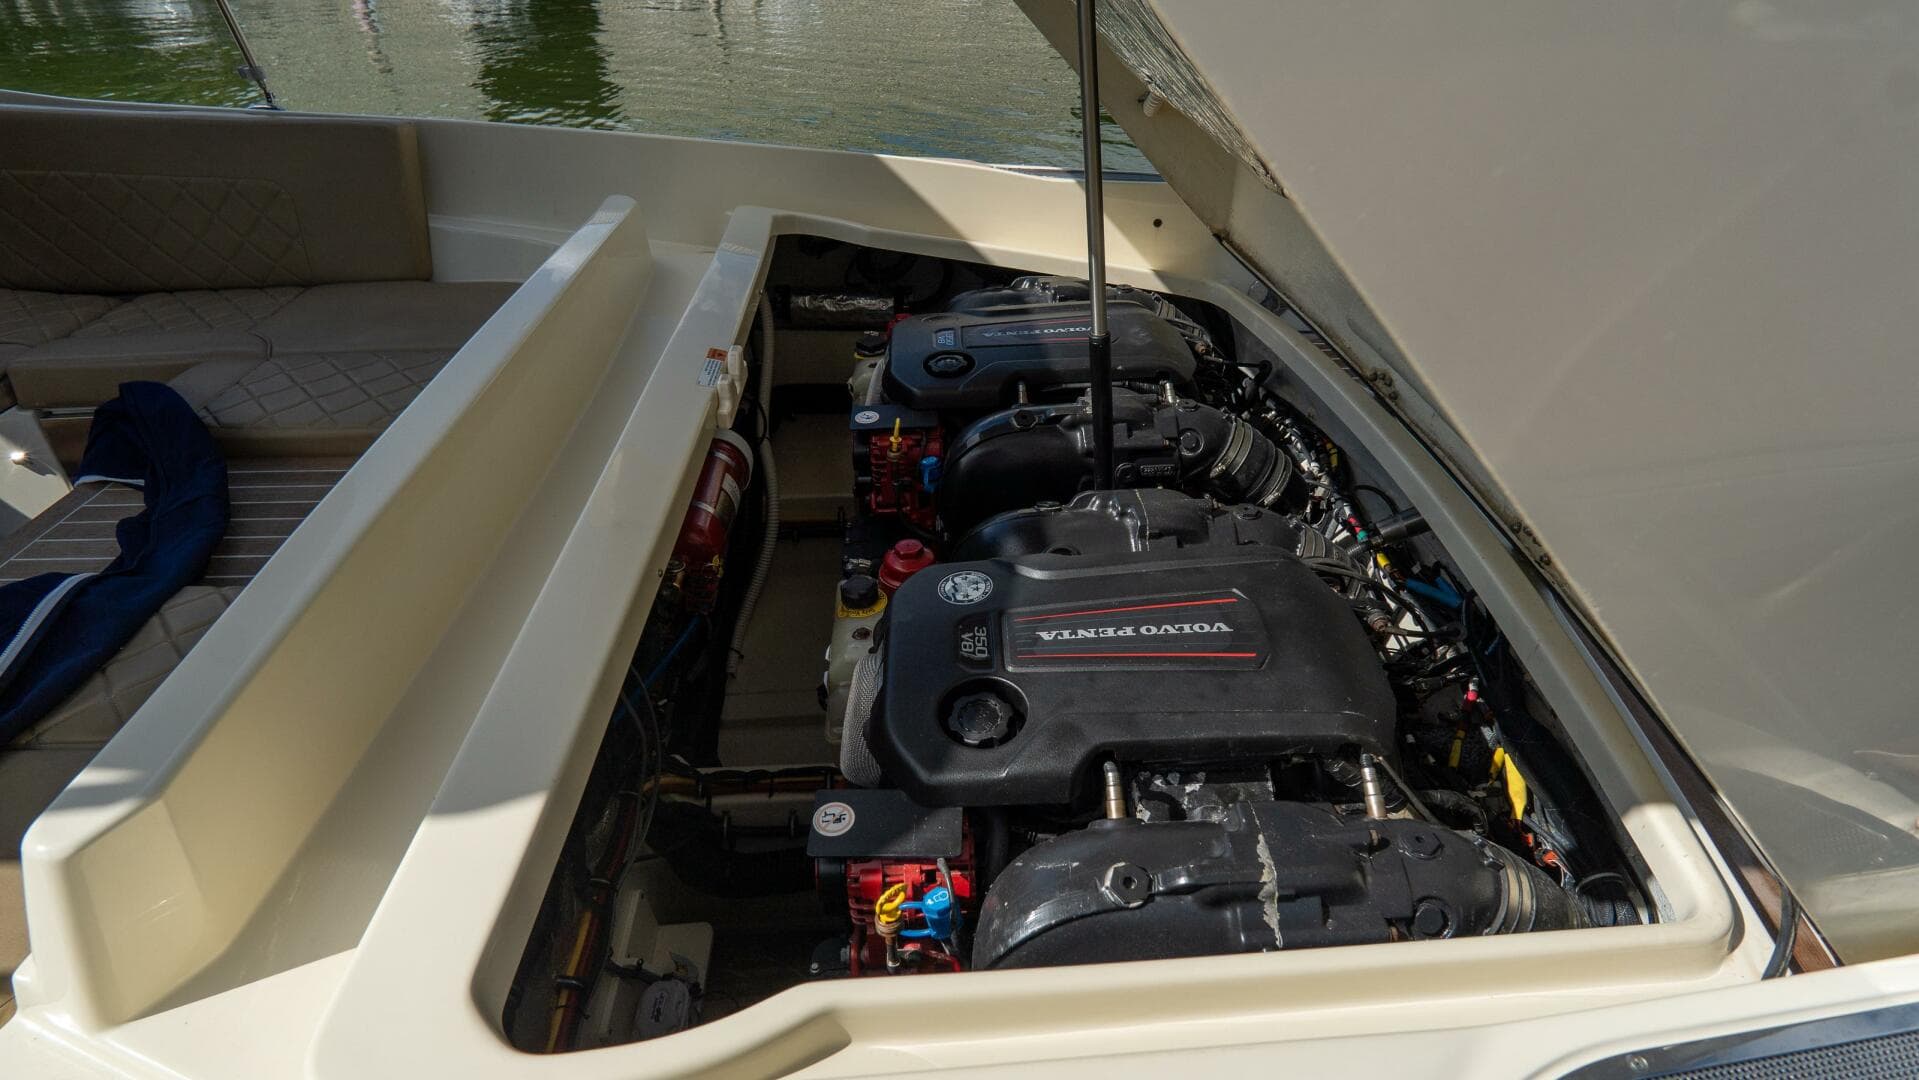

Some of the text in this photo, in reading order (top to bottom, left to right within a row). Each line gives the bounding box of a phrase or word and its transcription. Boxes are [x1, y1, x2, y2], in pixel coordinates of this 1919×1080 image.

[983, 328, 1041, 337] PENTA
[1036, 621, 1234, 641] VOLVO PENTA
[960, 632, 974, 652] V8
[974, 626, 988, 658] 350
